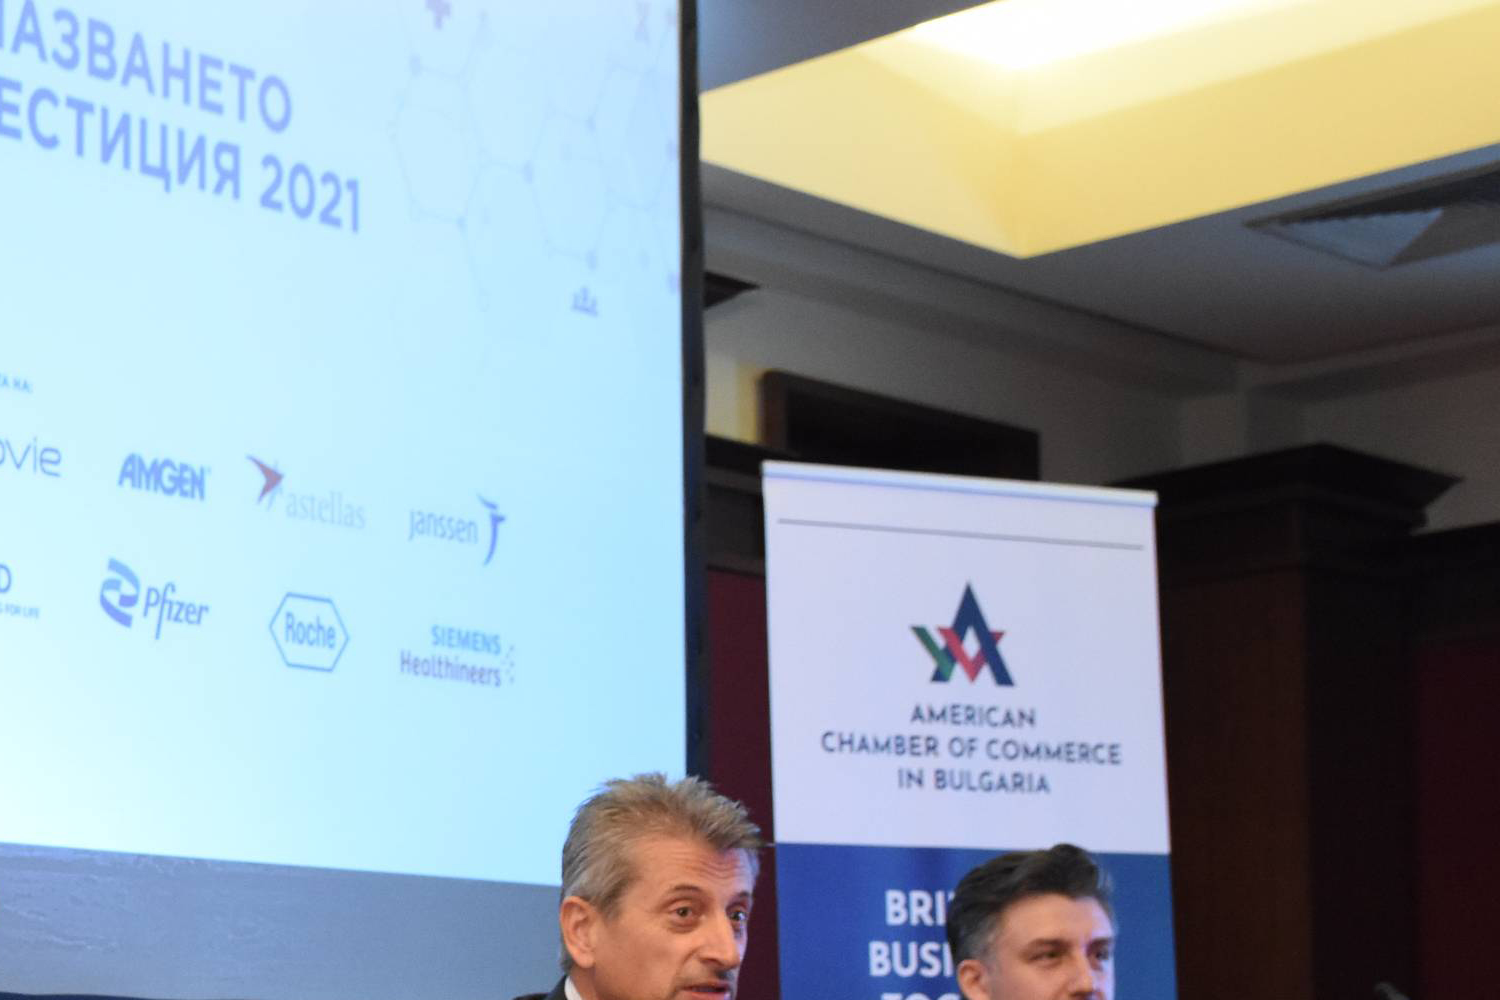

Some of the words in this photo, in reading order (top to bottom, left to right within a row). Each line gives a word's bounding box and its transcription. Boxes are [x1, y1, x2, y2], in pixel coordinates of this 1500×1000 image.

[259, 153, 359, 234] 2021
[118, 452, 206, 501] AMGEN
[285, 489, 367, 531] astellas
[144, 582, 210, 640] Pfizer
[284, 611, 336, 650] Roche
[430, 624, 501, 656] SIEMENS
[400, 649, 501, 688] Healthineers
[910, 704, 1037, 729] AMERICAN
[821, 731, 940, 758] CHAMBER
[949, 737, 980, 760] OF
[986, 741, 1123, 766] COMMERCE
[897, 769, 925, 790] IN
[934, 771, 1052, 796] BULGARIA
[885, 889, 956, 927] BRI
